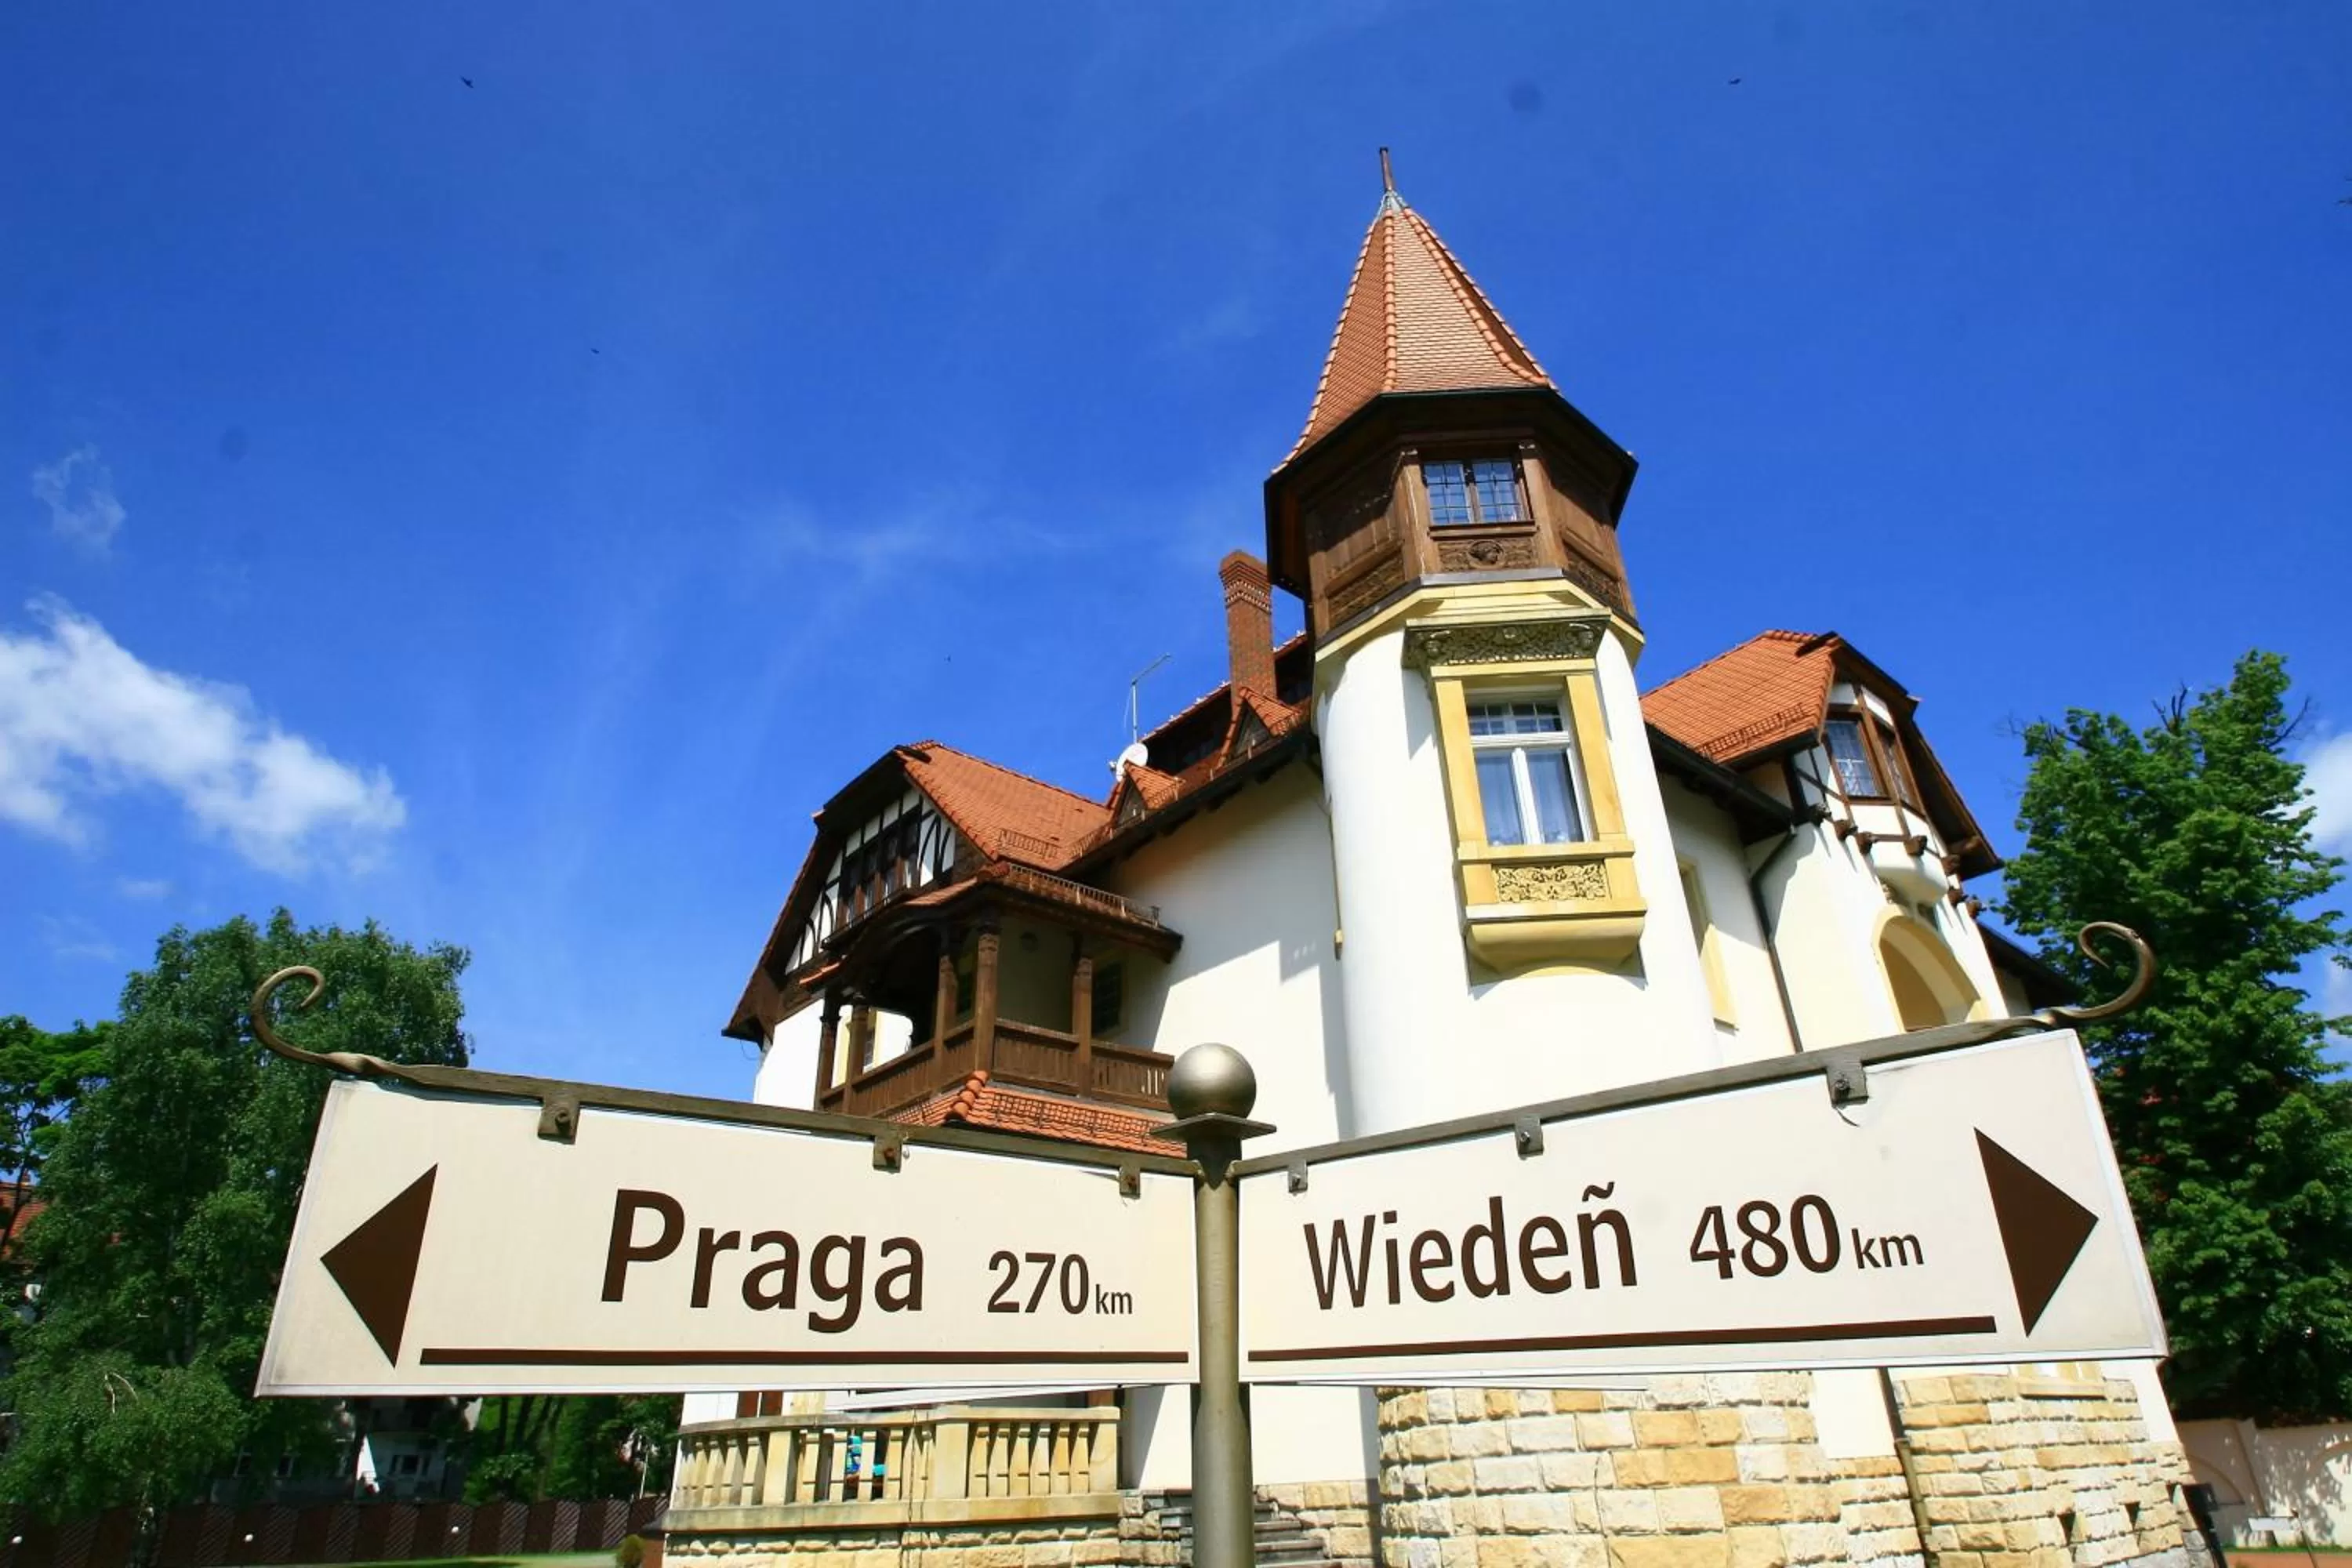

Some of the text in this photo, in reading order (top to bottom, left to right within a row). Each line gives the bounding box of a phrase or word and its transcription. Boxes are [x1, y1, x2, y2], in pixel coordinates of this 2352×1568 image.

[601, 1189, 1133, 1334] Praga 270 km
[1690, 1194, 1841, 1280] 480
[1851, 1228, 1924, 1269] km
